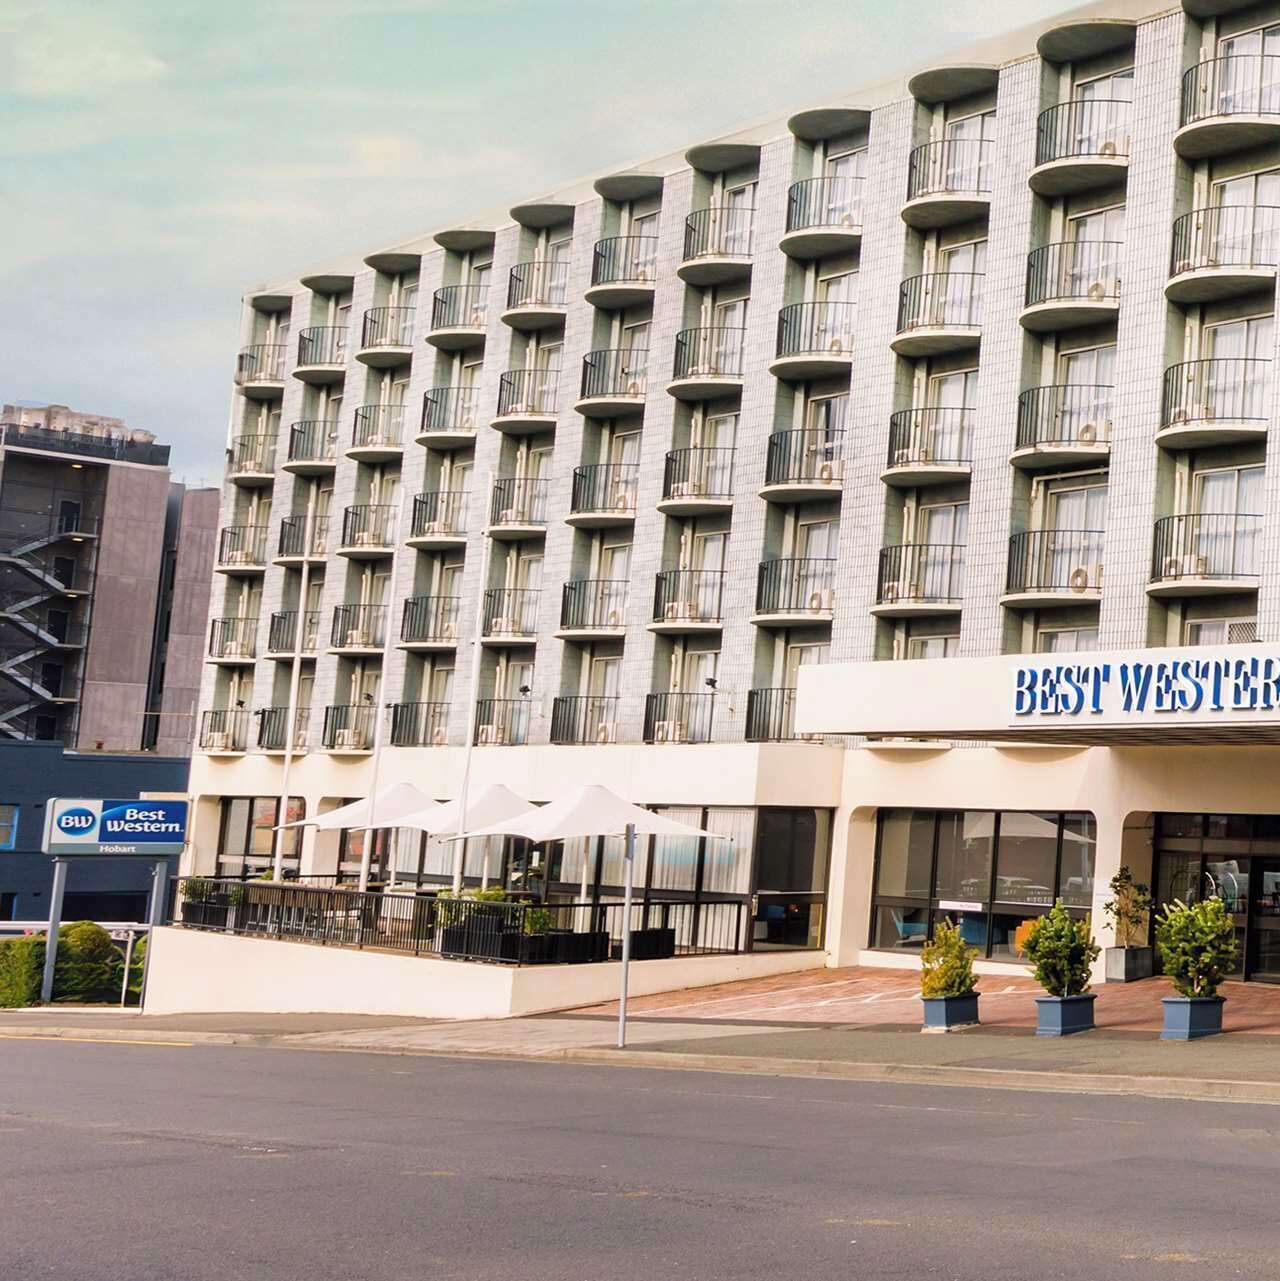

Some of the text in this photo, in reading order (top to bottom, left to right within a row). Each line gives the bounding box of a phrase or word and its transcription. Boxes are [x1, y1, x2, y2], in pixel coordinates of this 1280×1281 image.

[1014, 663, 1111, 715] BEST
[125, 808, 166, 821] Best
[60, 815, 93, 828] BW
[99, 845, 136, 854] Hobart
